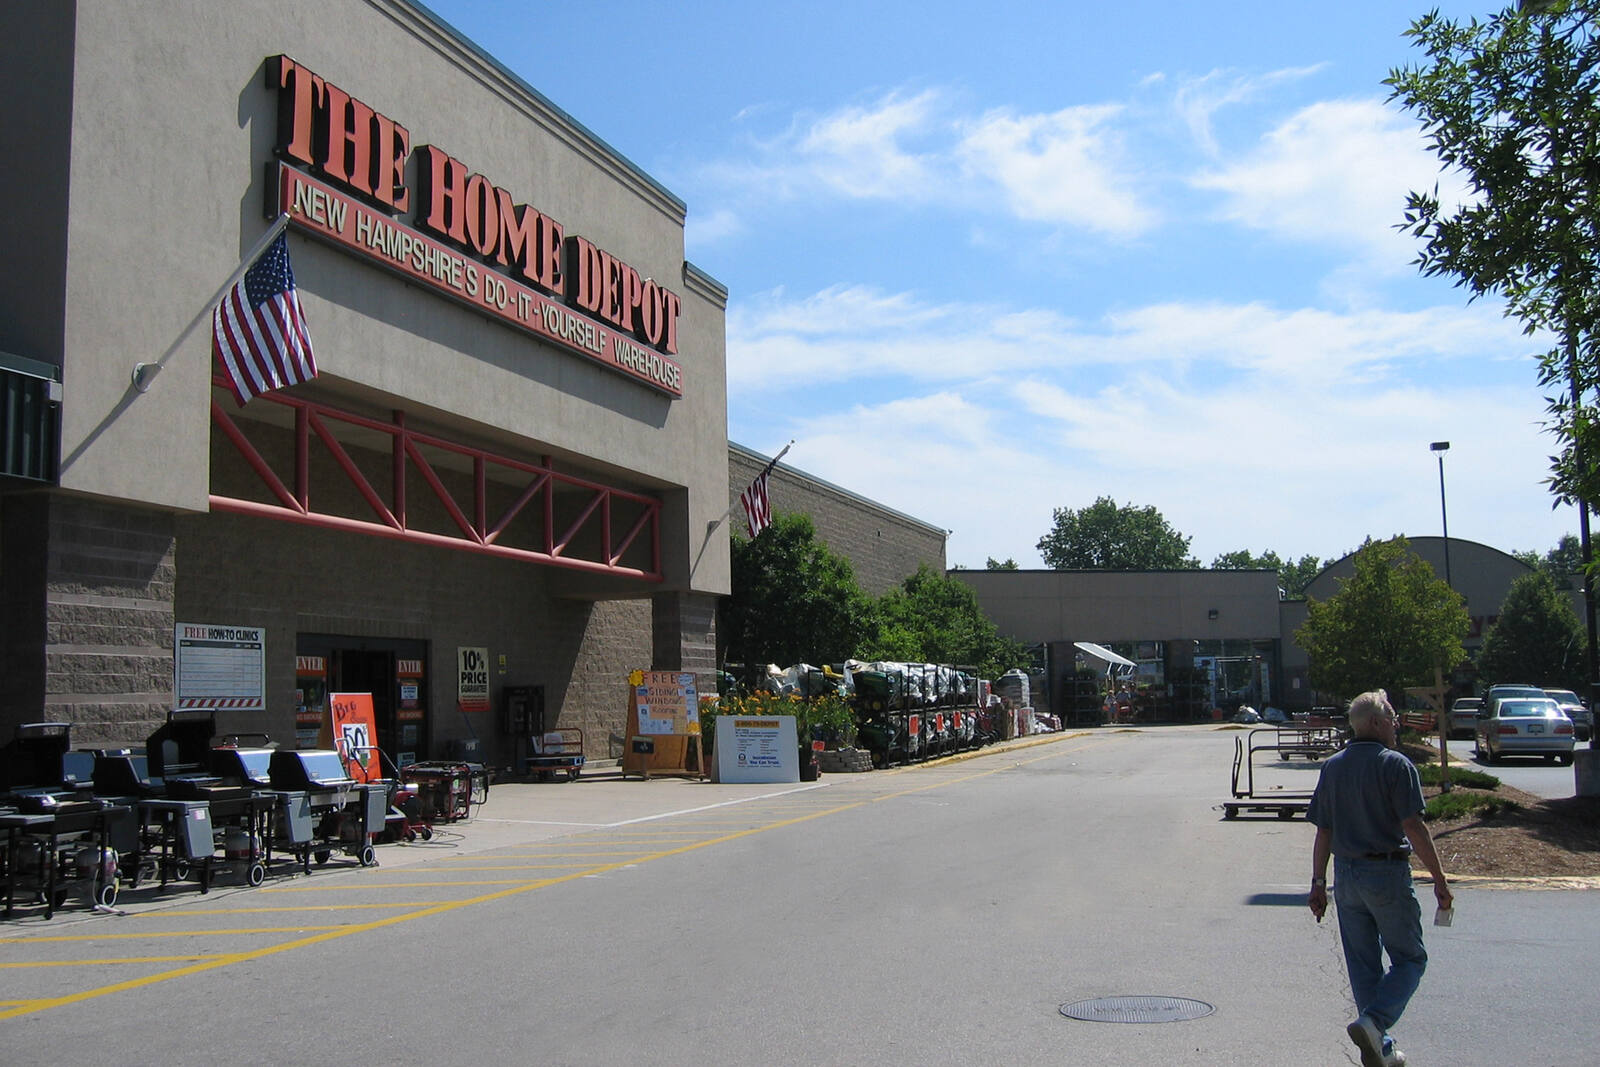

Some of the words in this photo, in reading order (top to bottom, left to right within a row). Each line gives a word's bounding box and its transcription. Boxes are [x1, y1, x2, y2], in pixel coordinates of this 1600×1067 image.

[278, 54, 410, 213] THE
[424, 144, 565, 296] HOME
[575, 236, 682, 355] DEPOT
[294, 179, 347, 233] NEW
[356, 209, 479, 297] HAMPSHIRE'S
[613, 336, 681, 390] WAREHOUSE
[184, 626, 206, 639] FREE
[235, 630, 259, 642] CLINICS
[296, 655, 324, 671] ENTER
[398, 659, 422, 673] ENTER
[462, 649, 485, 672] 10%
[461, 671, 487, 685] PRICE
